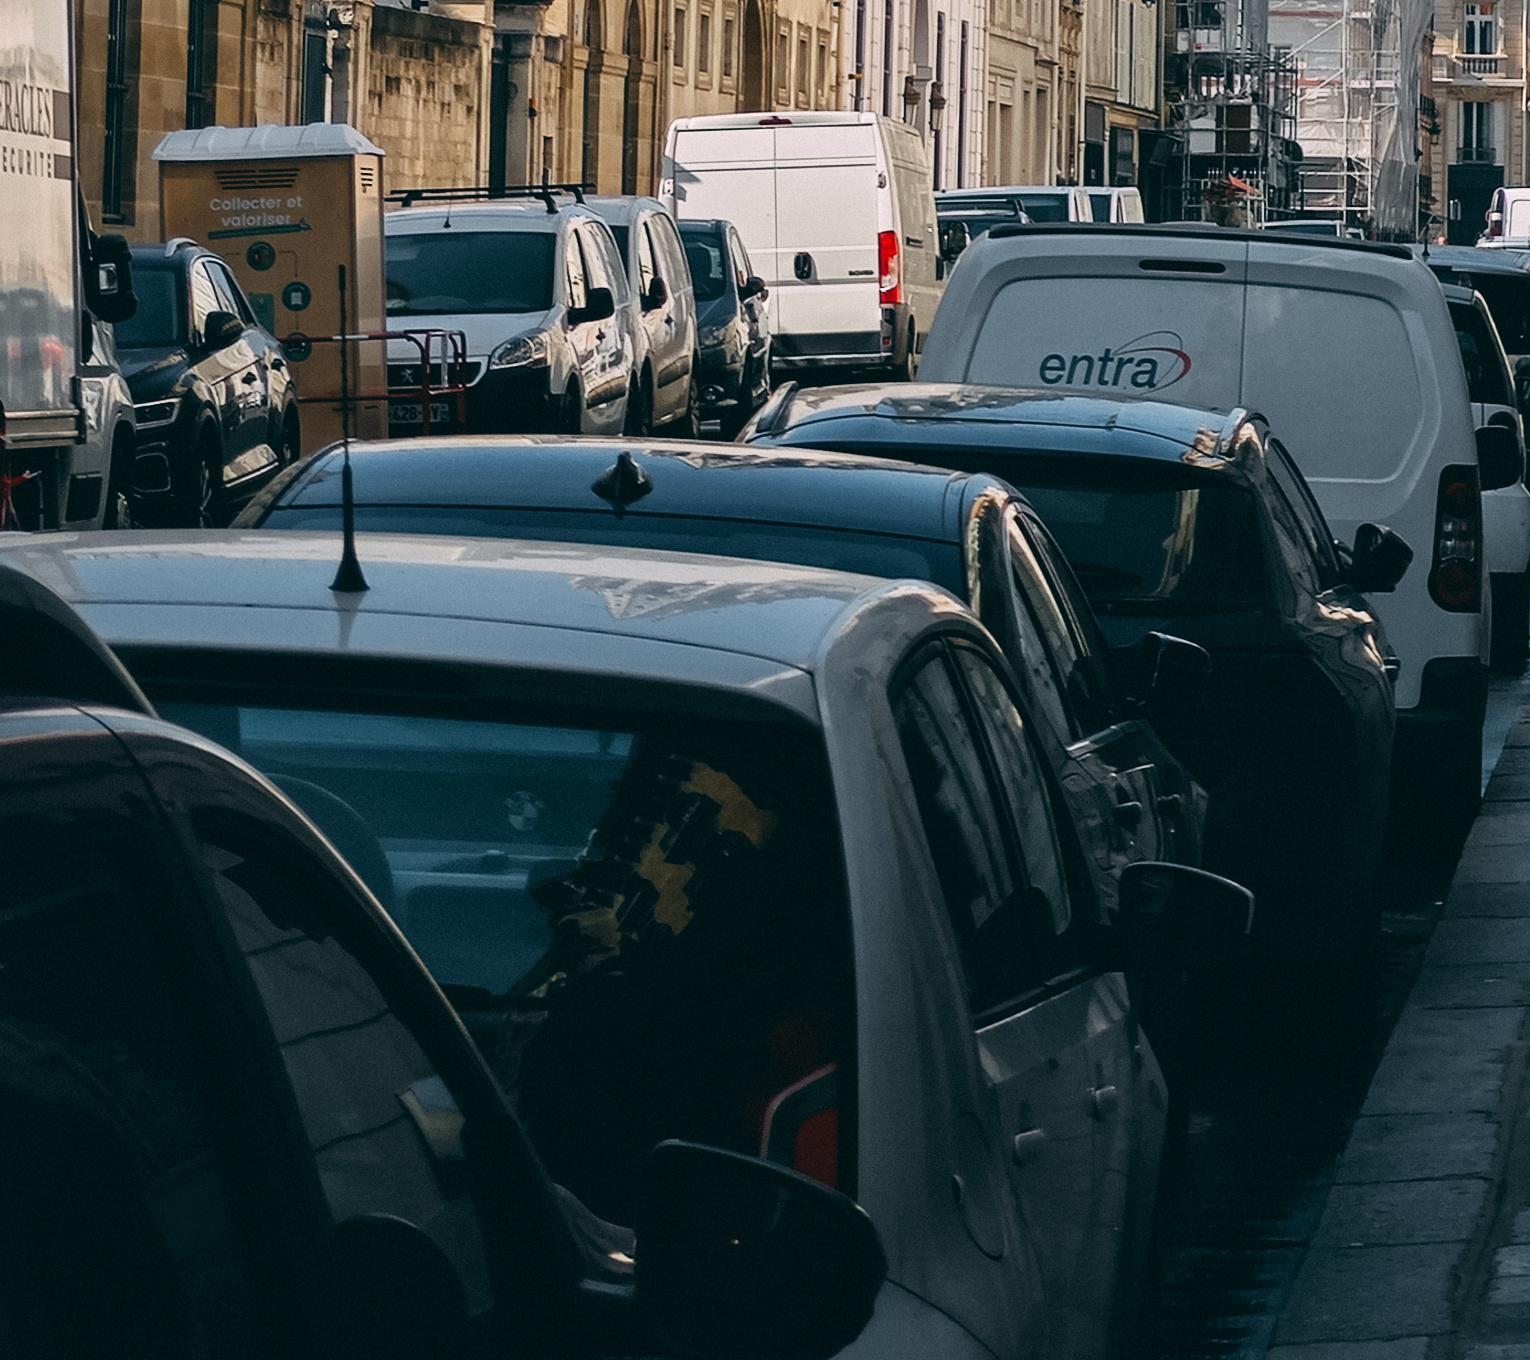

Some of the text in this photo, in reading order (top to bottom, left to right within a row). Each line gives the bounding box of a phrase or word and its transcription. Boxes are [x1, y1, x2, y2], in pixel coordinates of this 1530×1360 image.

[209, 196, 303, 211] Collecter et
[222, 213, 291, 227] valoriser
[1039, 348, 1158, 388] entra
